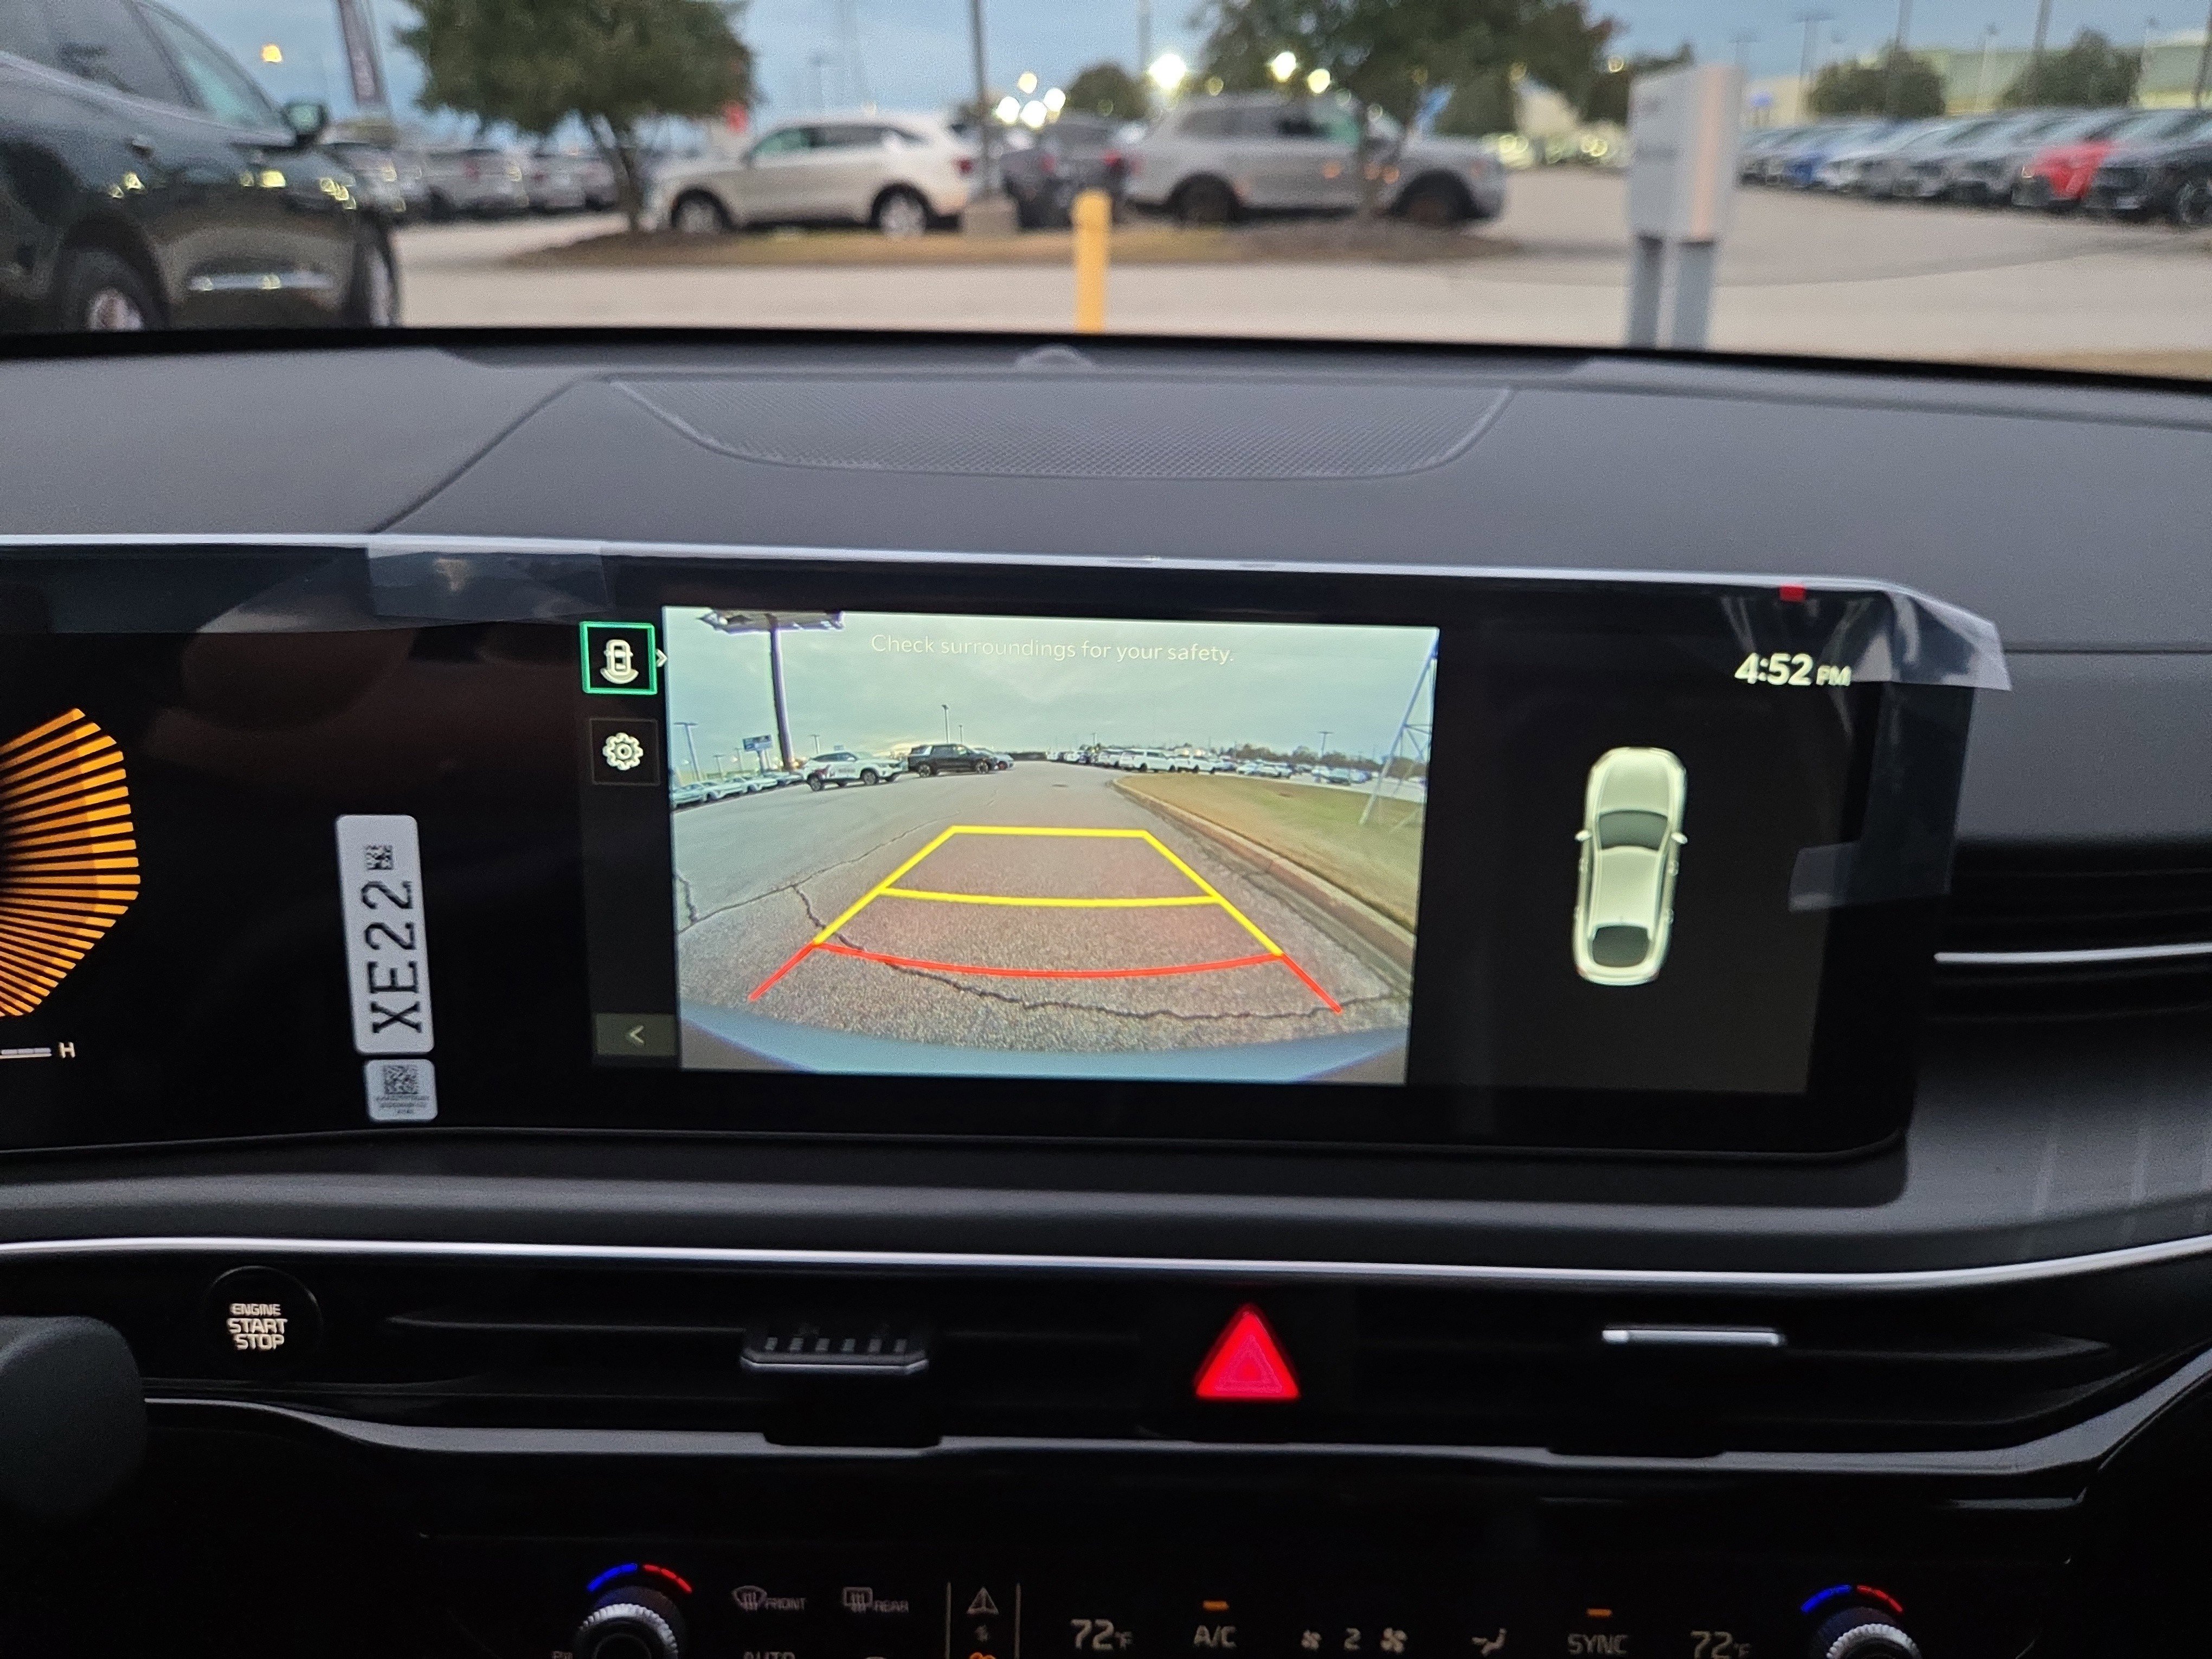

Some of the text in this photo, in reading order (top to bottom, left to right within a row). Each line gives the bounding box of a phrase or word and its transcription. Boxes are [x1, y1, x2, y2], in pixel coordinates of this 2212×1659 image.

[871, 634, 1235, 666] Check surroundings for your safety.
[1734, 652, 1852, 686] 4:52 PM
[361, 880, 422, 1034] XE22
[59, 1041, 75, 1058] H
[229, 1303, 281, 1316] ENGINE
[226, 1317, 288, 1334] START
[233, 1333, 285, 1351] STOP
[766, 1597, 806, 1611] FRONT
[872, 1600, 909, 1613] REAR
[1193, 1625, 1237, 1648] A/C
[1344, 1628, 1361, 1650] 2
[1567, 1633, 1627, 1655] SYNC
